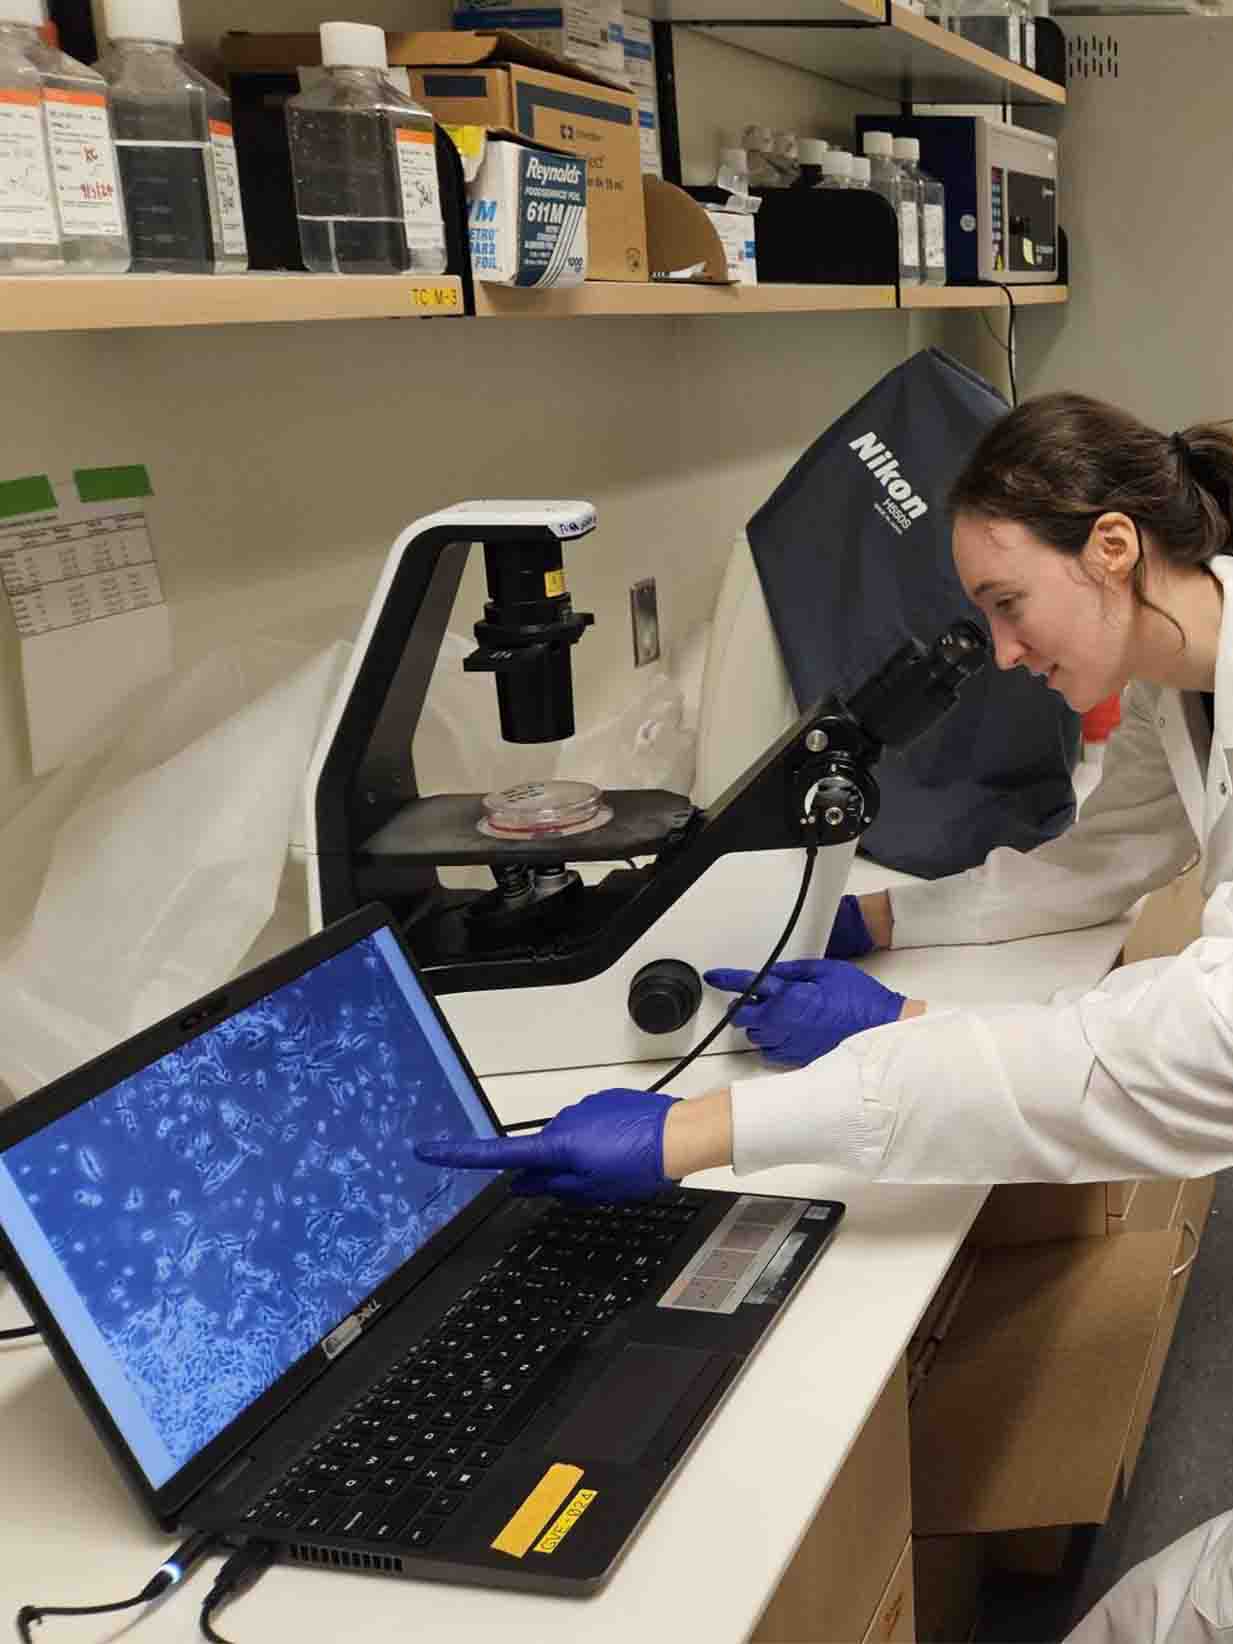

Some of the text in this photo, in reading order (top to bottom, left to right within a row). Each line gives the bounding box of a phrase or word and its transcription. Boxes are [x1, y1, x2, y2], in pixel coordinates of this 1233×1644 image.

[525, 156, 582, 186] Reynolds
[526, 201, 565, 224] 611M
[848, 432, 928, 519] Nikon
[540, 1490, 594, 1551] GVE-024
